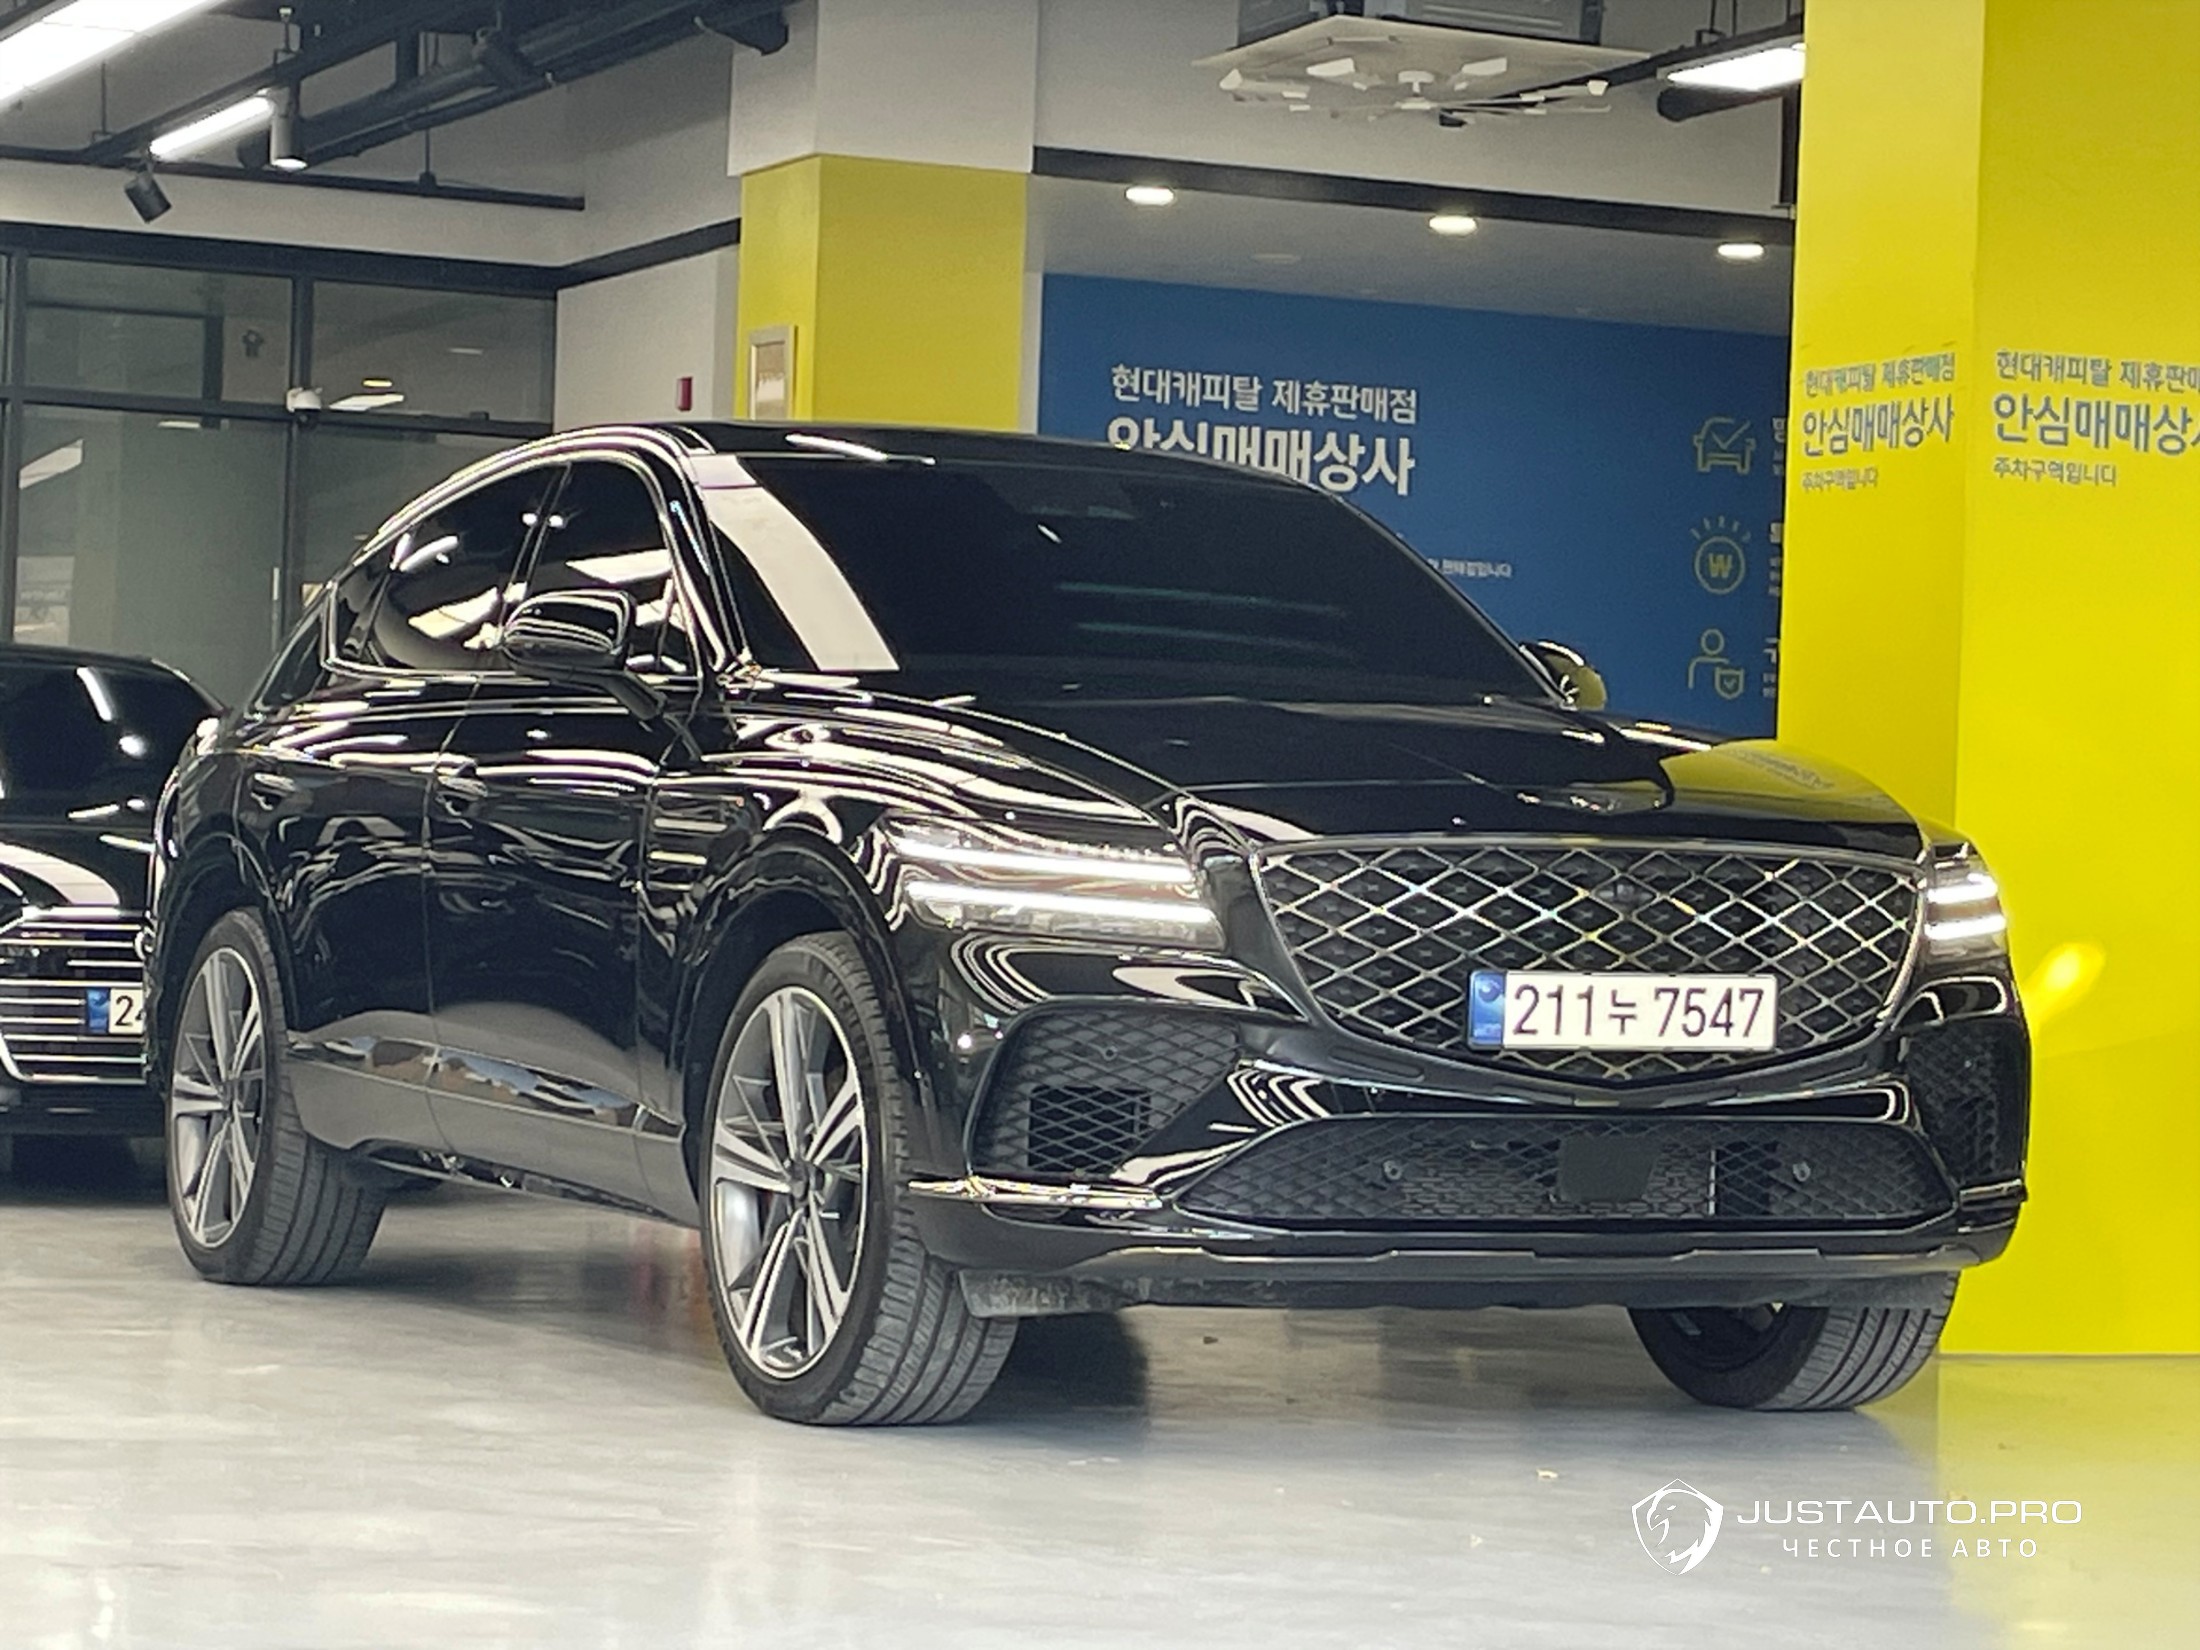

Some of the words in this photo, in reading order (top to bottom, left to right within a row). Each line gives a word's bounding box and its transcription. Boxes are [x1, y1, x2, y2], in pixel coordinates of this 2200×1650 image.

[1111, 364, 1263, 412] 현대캐피탈
[1272, 379, 1417, 425] 제휴판매점
[1806, 364, 1876, 397] 현대캐피탈
[1882, 352, 1955, 388] 제휴판매점
[1997, 350, 2111, 388] 현대캐피탈
[1803, 394, 1955, 457] 안심매매상사
[1994, 394, 2200, 456] 안심매매상
[1994, 457, 2117, 486] 주차구역입니다
[1513, 984, 1637, 1036] 211누
[1653, 987, 1764, 1037] 7547
